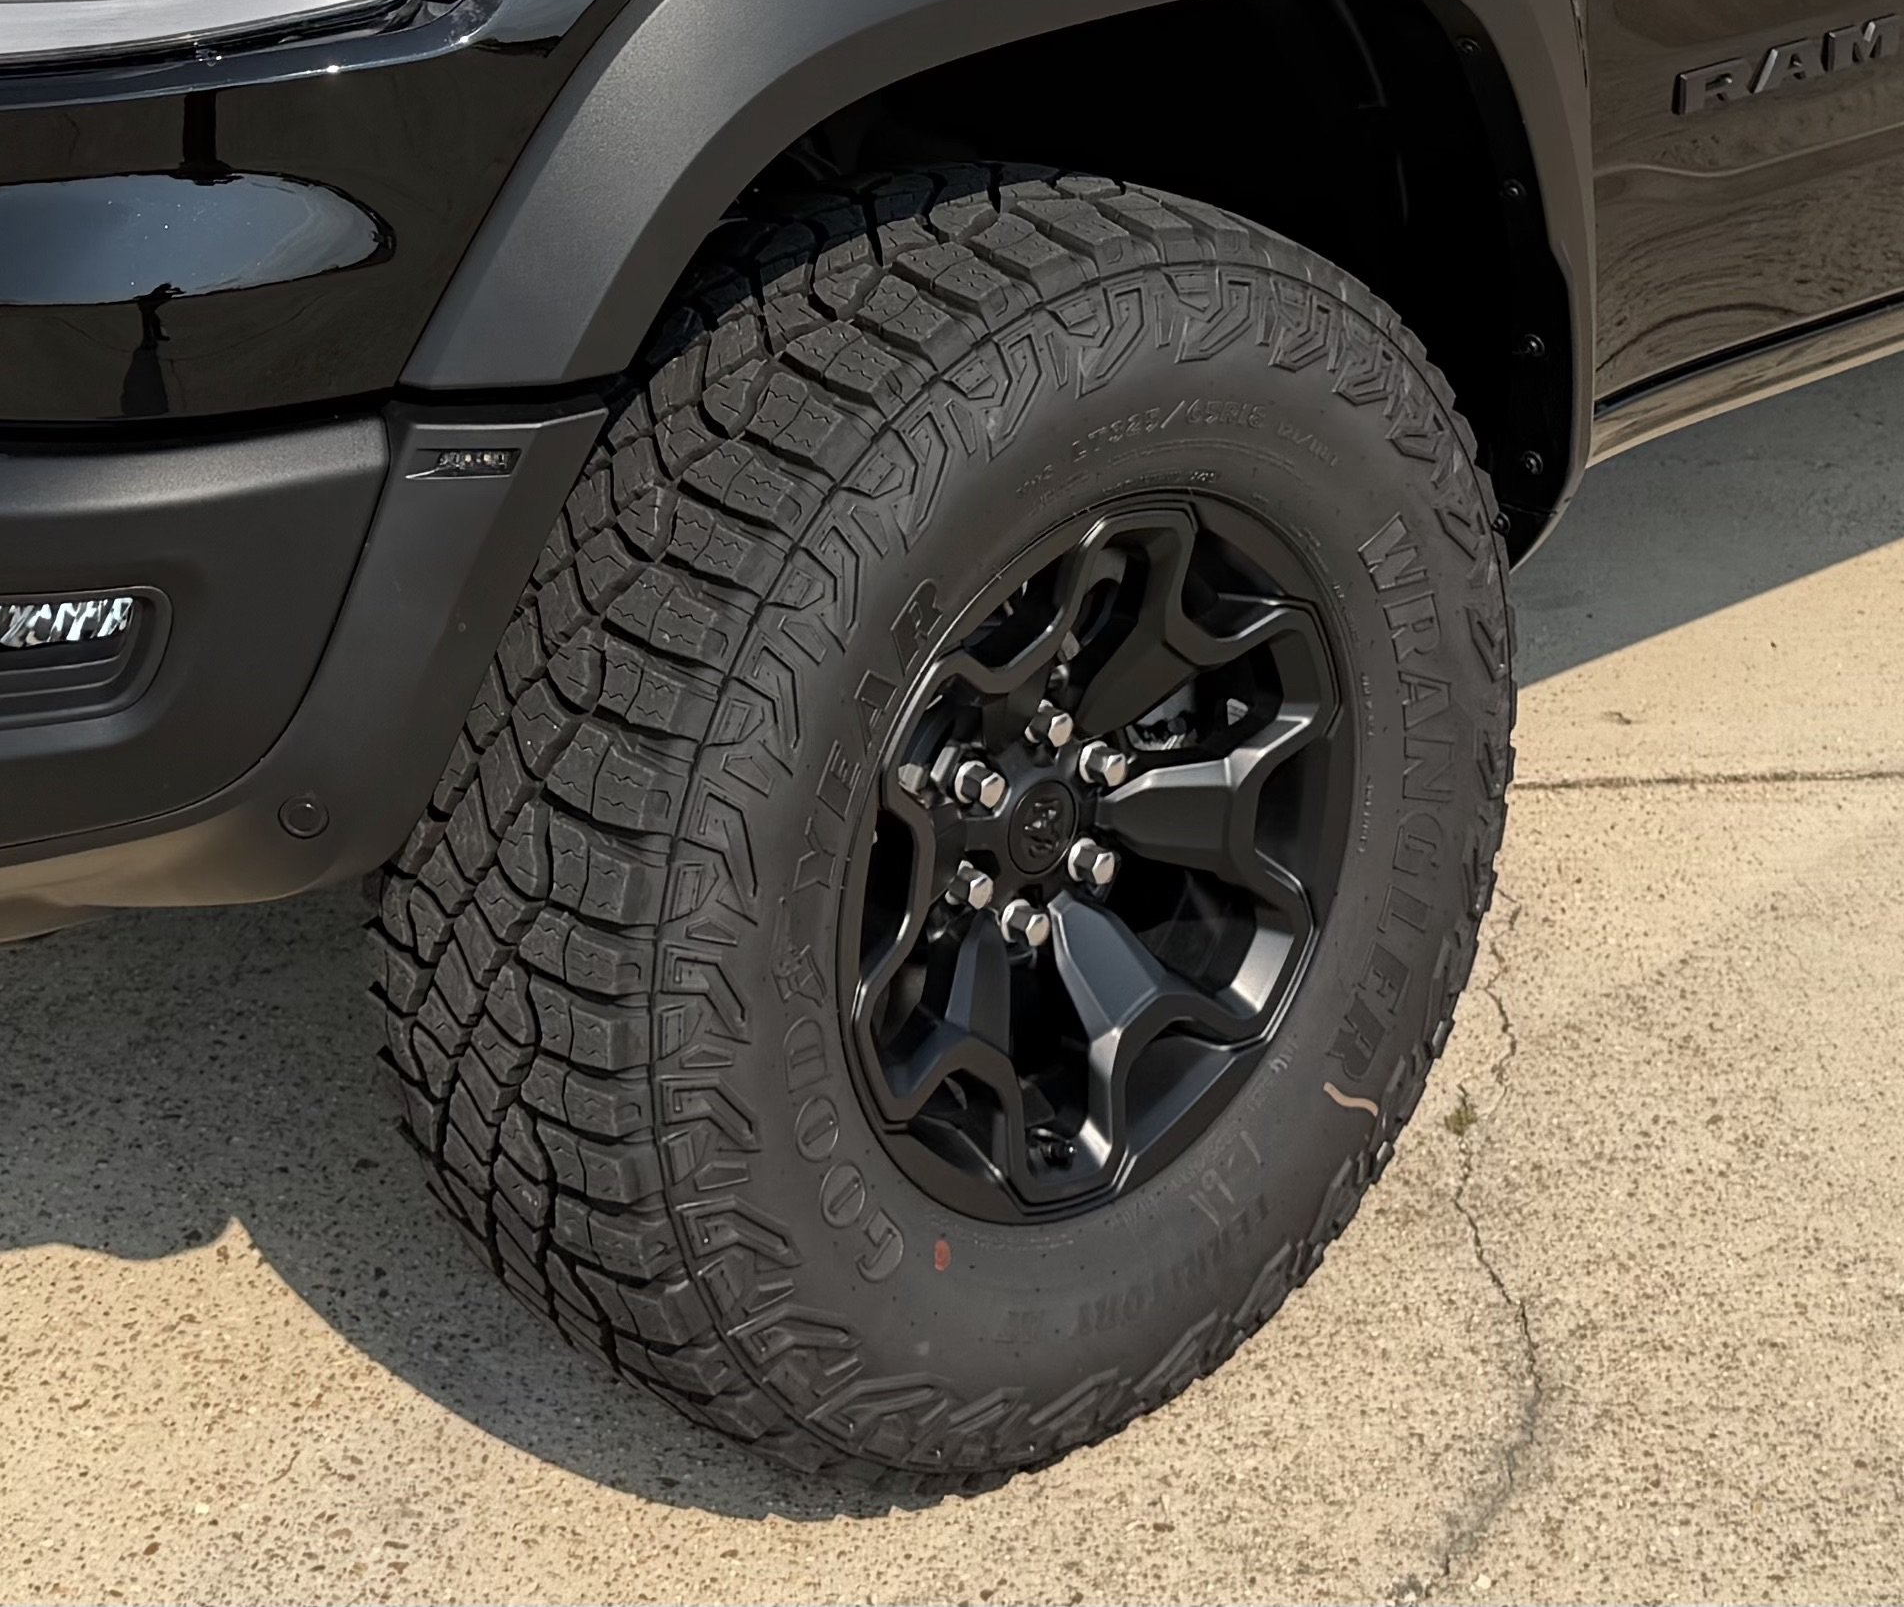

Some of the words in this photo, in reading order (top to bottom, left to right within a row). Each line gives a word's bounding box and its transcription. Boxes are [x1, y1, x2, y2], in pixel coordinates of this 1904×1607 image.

[1670, 12, 1902, 116] RAM
[770, 575, 945, 1286] GOODYEAR
[1322, 509, 1457, 1084] WRANGLER
